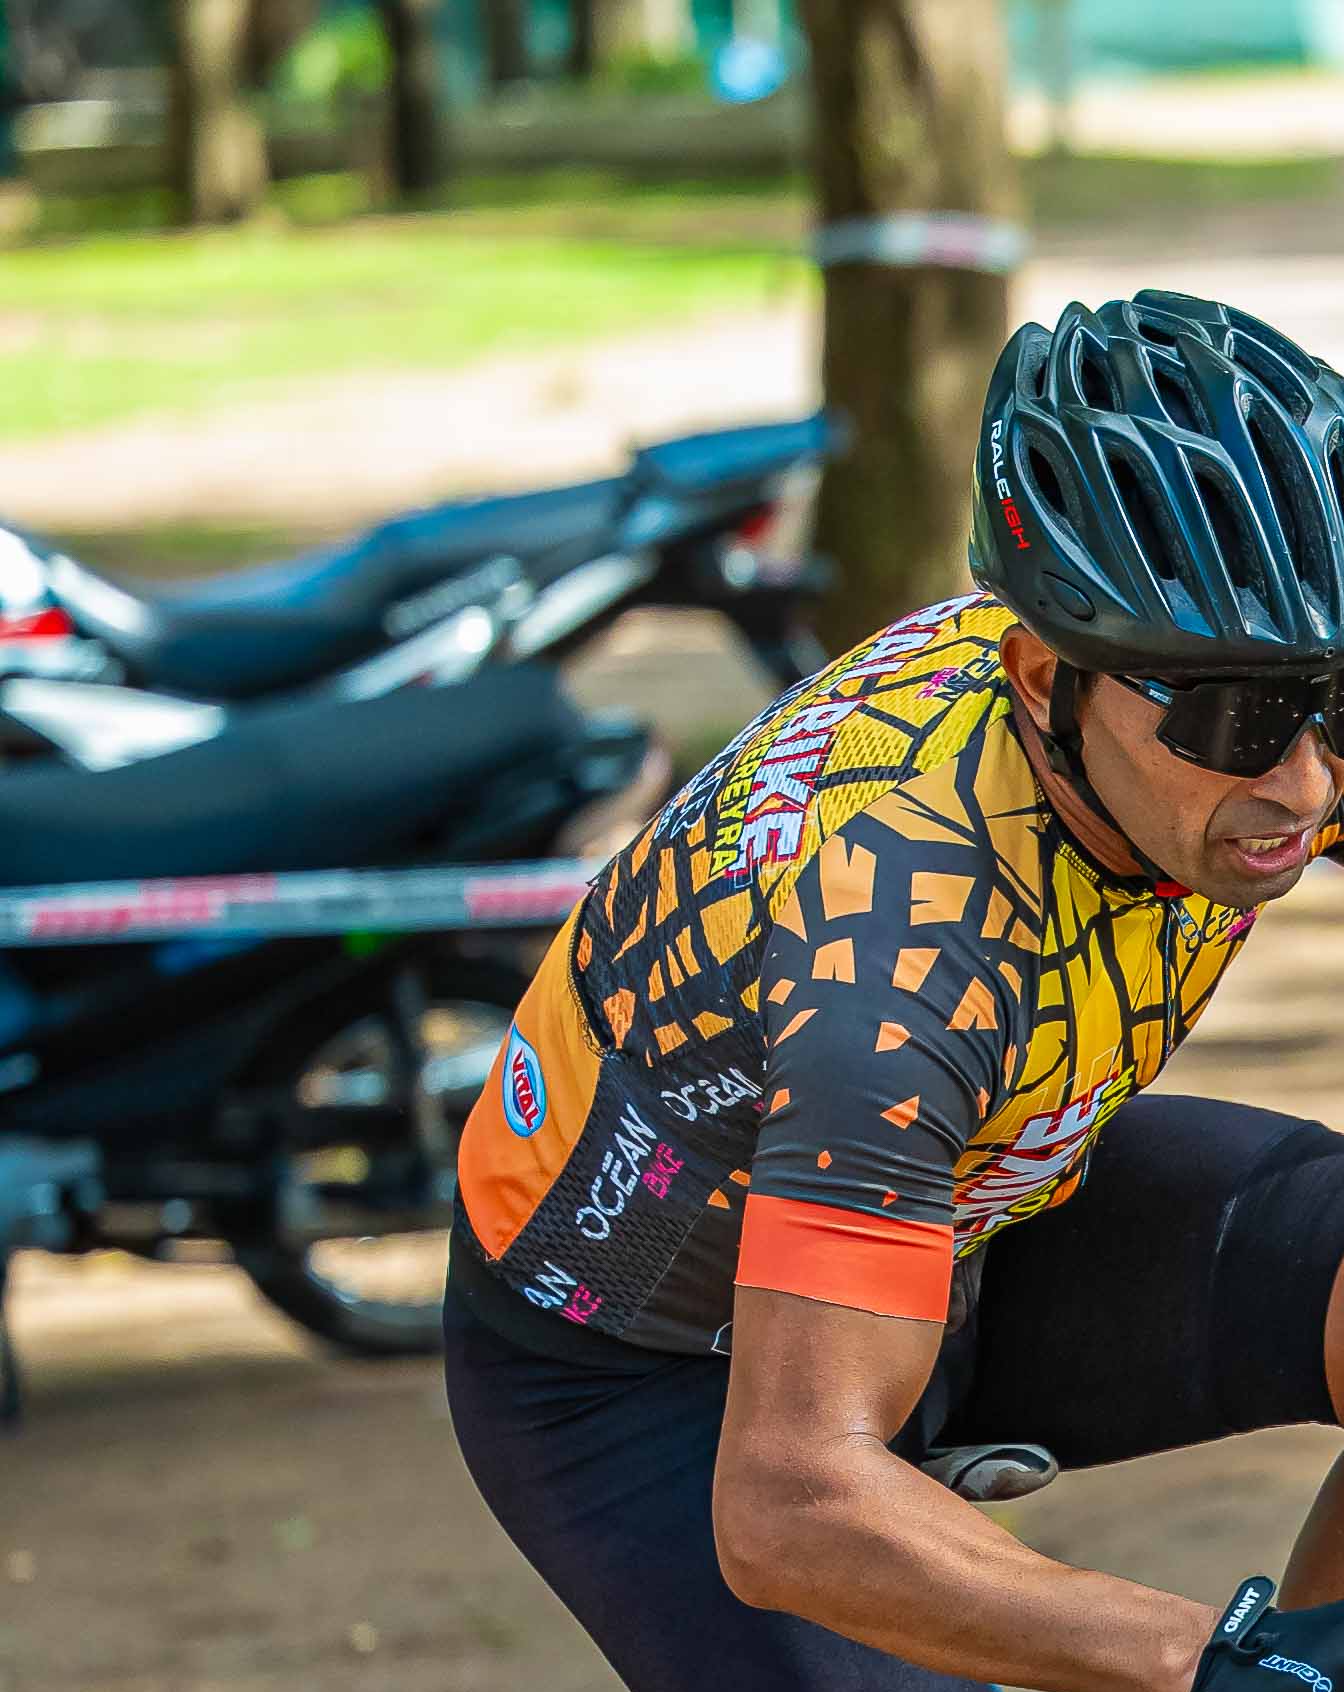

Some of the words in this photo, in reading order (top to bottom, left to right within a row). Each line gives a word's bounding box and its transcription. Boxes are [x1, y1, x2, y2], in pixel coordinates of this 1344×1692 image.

[990, 419, 1031, 549] RALEIGH
[728, 697, 866, 880] BIKE
[660, 1067, 763, 1122] OCEAN
[575, 1103, 658, 1241] OCEAN
[1223, 1586, 1261, 1634] GIANT
[1258, 1654, 1322, 1684] GIANT
